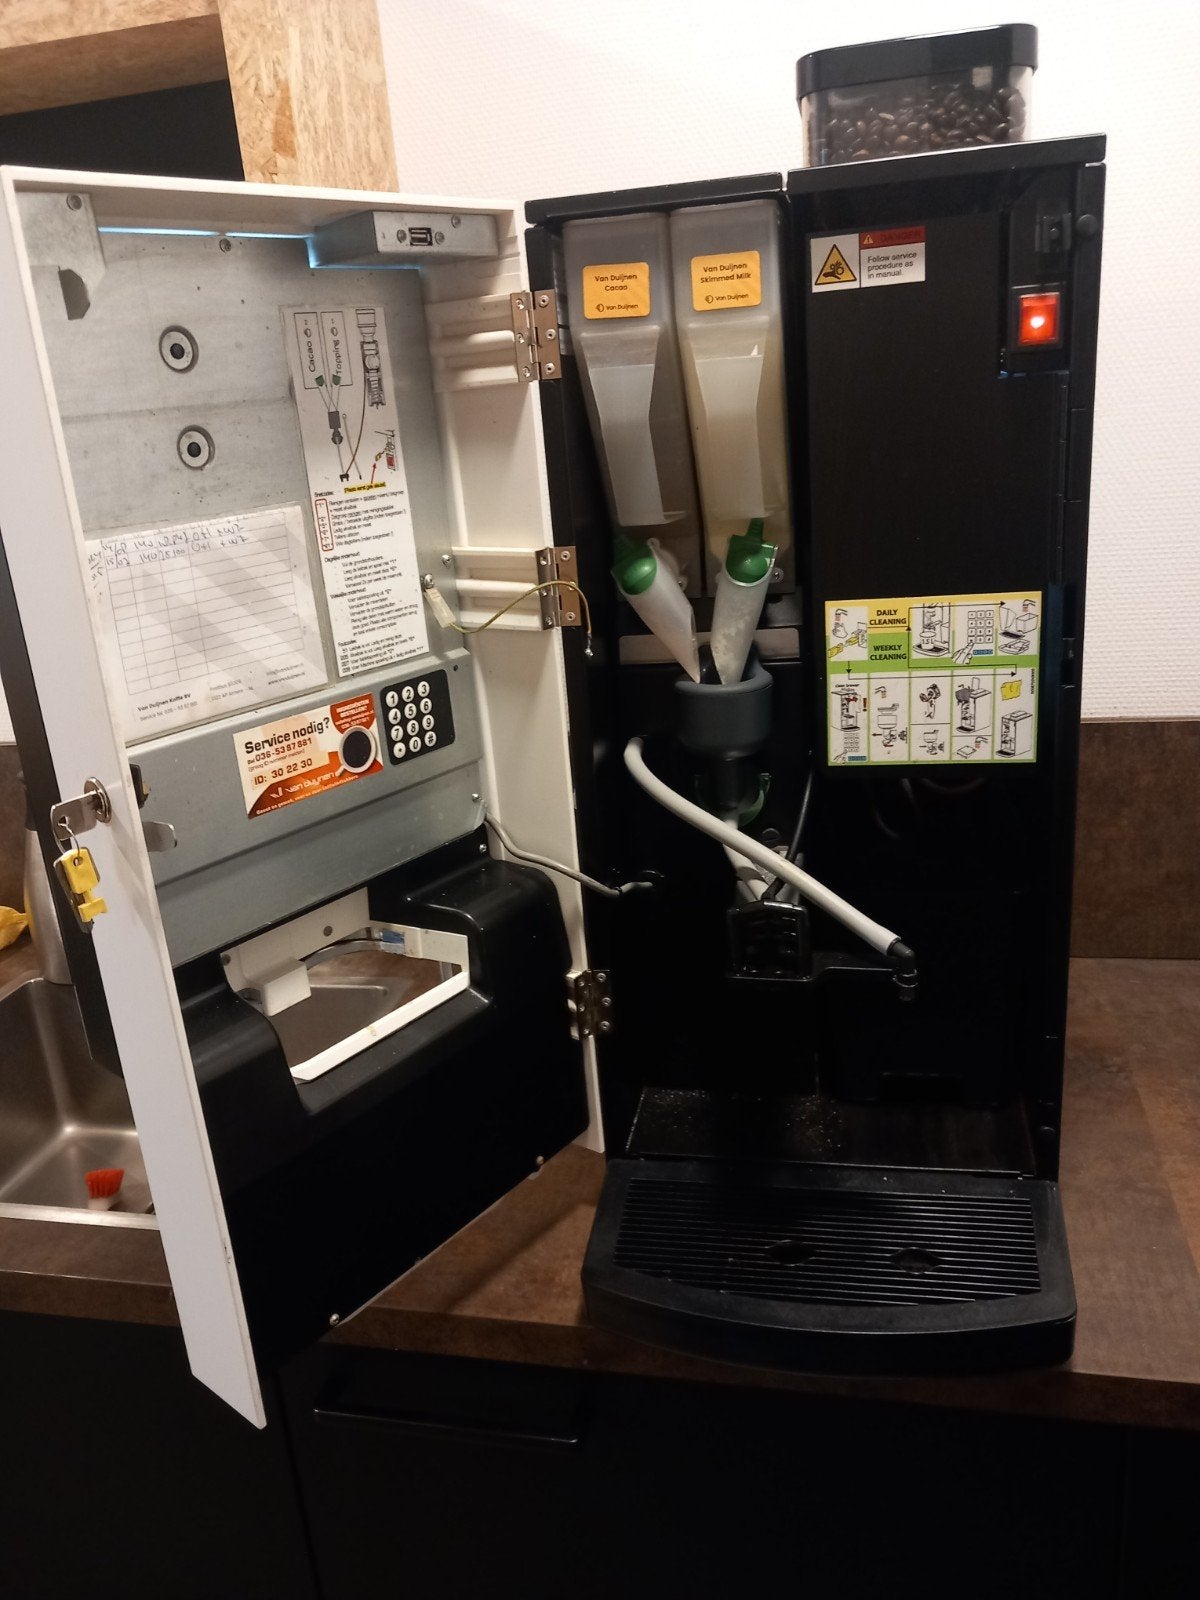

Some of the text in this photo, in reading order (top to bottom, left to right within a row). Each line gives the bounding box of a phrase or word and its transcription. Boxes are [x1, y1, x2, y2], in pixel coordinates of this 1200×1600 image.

[720, 263, 748, 272] Duijnen
[868, 262, 903, 271] procedure
[610, 274, 637, 282] Duijnen
[700, 274, 735, 284] Skimmed
[727, 293, 748, 301] Duijnen
[617, 303, 638, 311] Duijnen
[307, 341, 315, 372] Cacao
[333, 340, 342, 374] Topping
[391, 684, 427, 704] 1 2 3
[393, 701, 429, 721] 4 5 6
[245, 734, 290, 754] Service
[292, 717, 329, 739] nodig?
[394, 718, 431, 739] 7 8 9
[413, 740, 418, 750] 0
[254, 758, 312, 785] ID: 30 22 30
